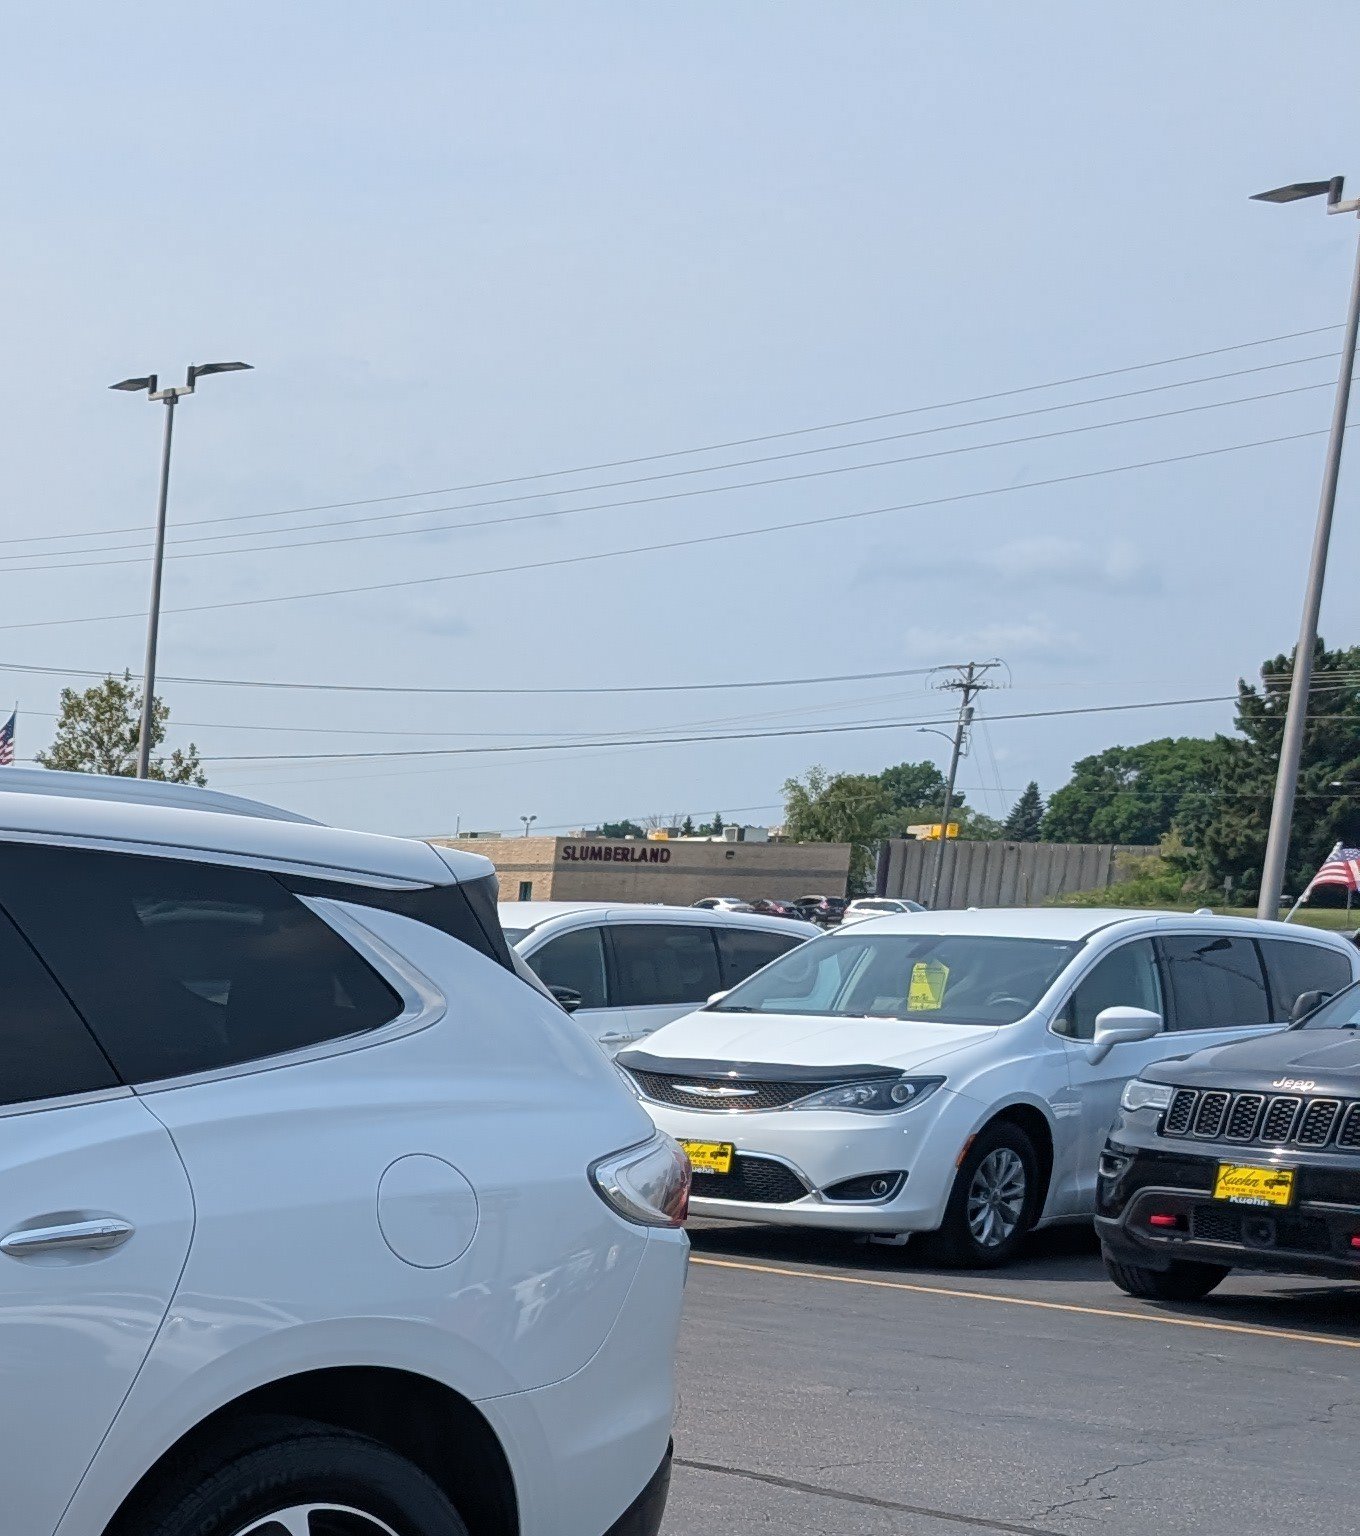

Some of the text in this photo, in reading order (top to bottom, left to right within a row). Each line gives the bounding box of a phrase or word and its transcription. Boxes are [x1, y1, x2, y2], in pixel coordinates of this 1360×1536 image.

[561, 845, 672, 863] SLUMBERLAND
[1273, 1076, 1315, 1091] Jeep
[1217, 1165, 1260, 1187] Kuehn
